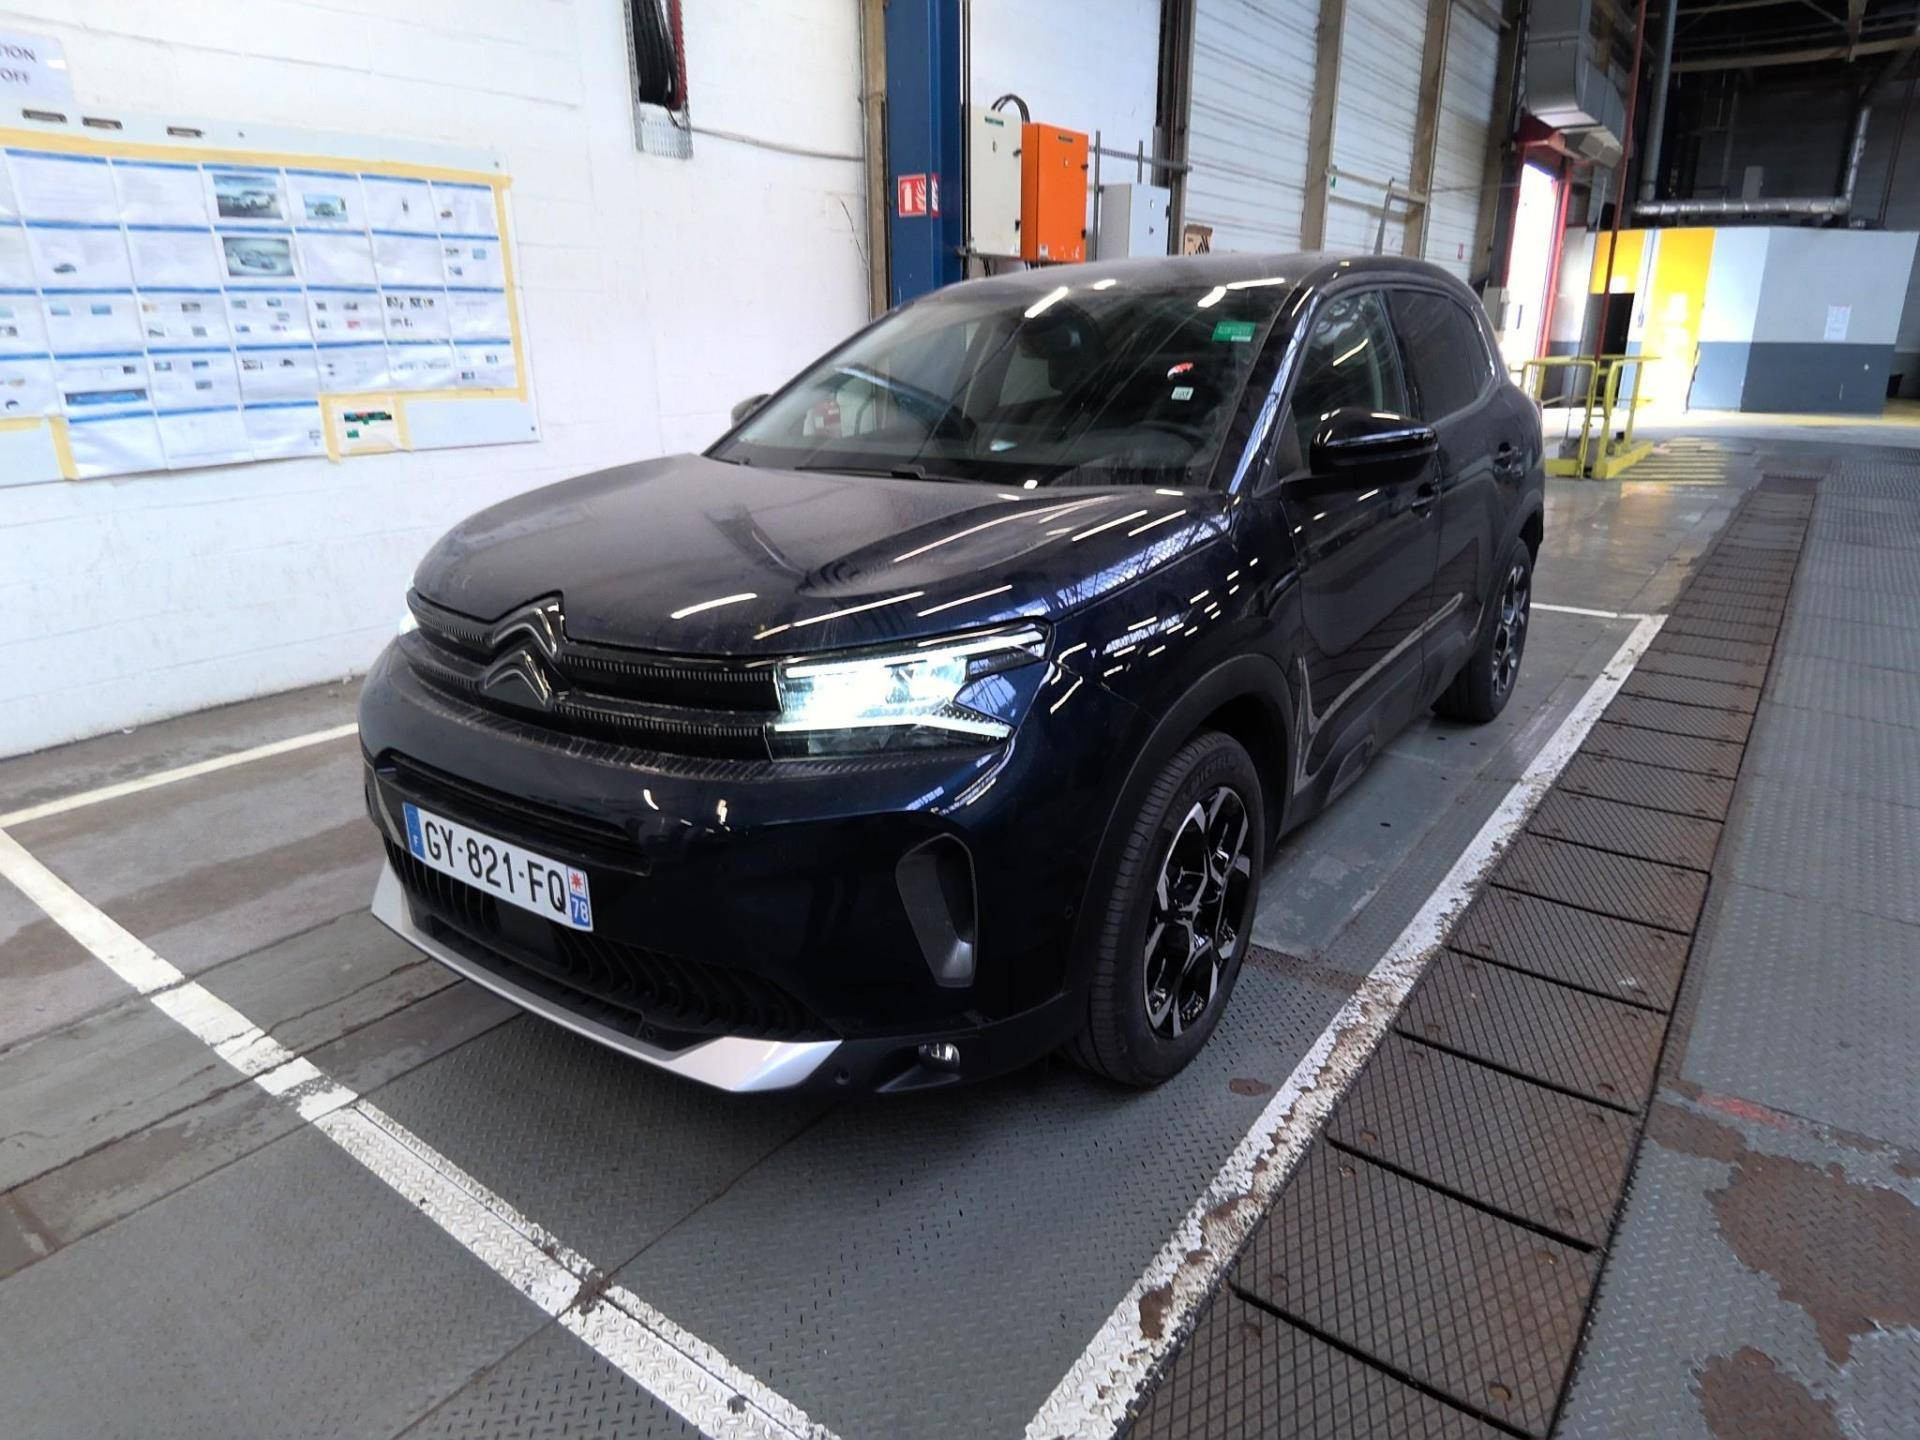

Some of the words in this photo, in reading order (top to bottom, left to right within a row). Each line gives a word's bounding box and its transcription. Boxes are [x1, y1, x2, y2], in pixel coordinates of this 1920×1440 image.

[0, 44, 37, 63] ION
[425, 820, 567, 915] GY-821-FQ
[571, 897, 589, 923] 78
